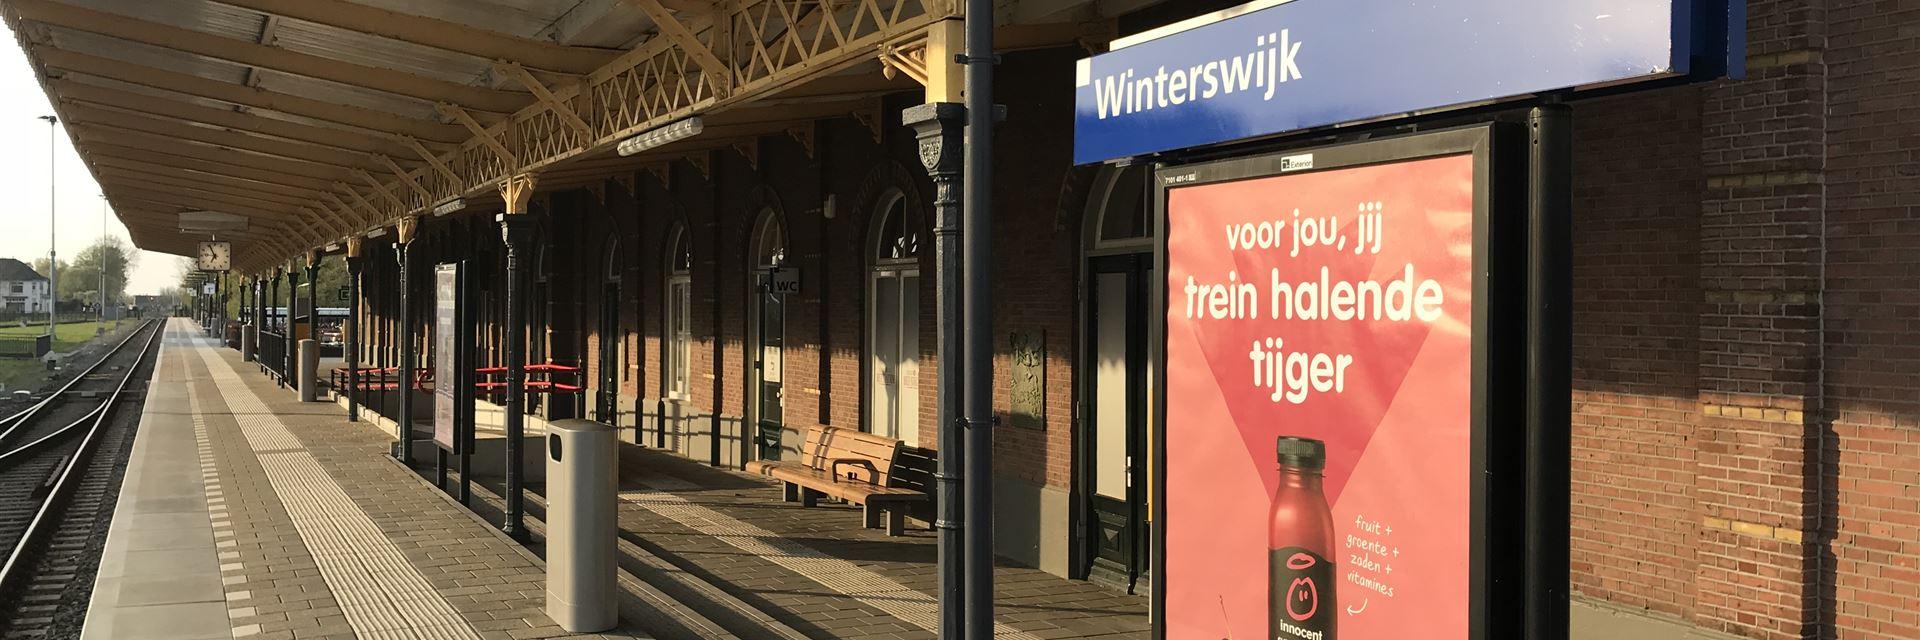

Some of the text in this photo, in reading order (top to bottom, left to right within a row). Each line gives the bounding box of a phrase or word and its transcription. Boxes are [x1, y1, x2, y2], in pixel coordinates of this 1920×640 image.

[1095, 28, 1302, 120] Winterswijk
[1226, 201, 1383, 257] voor jou, jij
[776, 281, 798, 292] WC
[1184, 262, 1444, 322] trein halende
[1249, 336, 1353, 404] tijger
[1355, 514, 1381, 535] fruit
[1345, 534, 1388, 557] groente
[1350, 552, 1381, 573] zaden
[1347, 569, 1394, 598] vitamines
[1280, 618, 1323, 640] innocent
